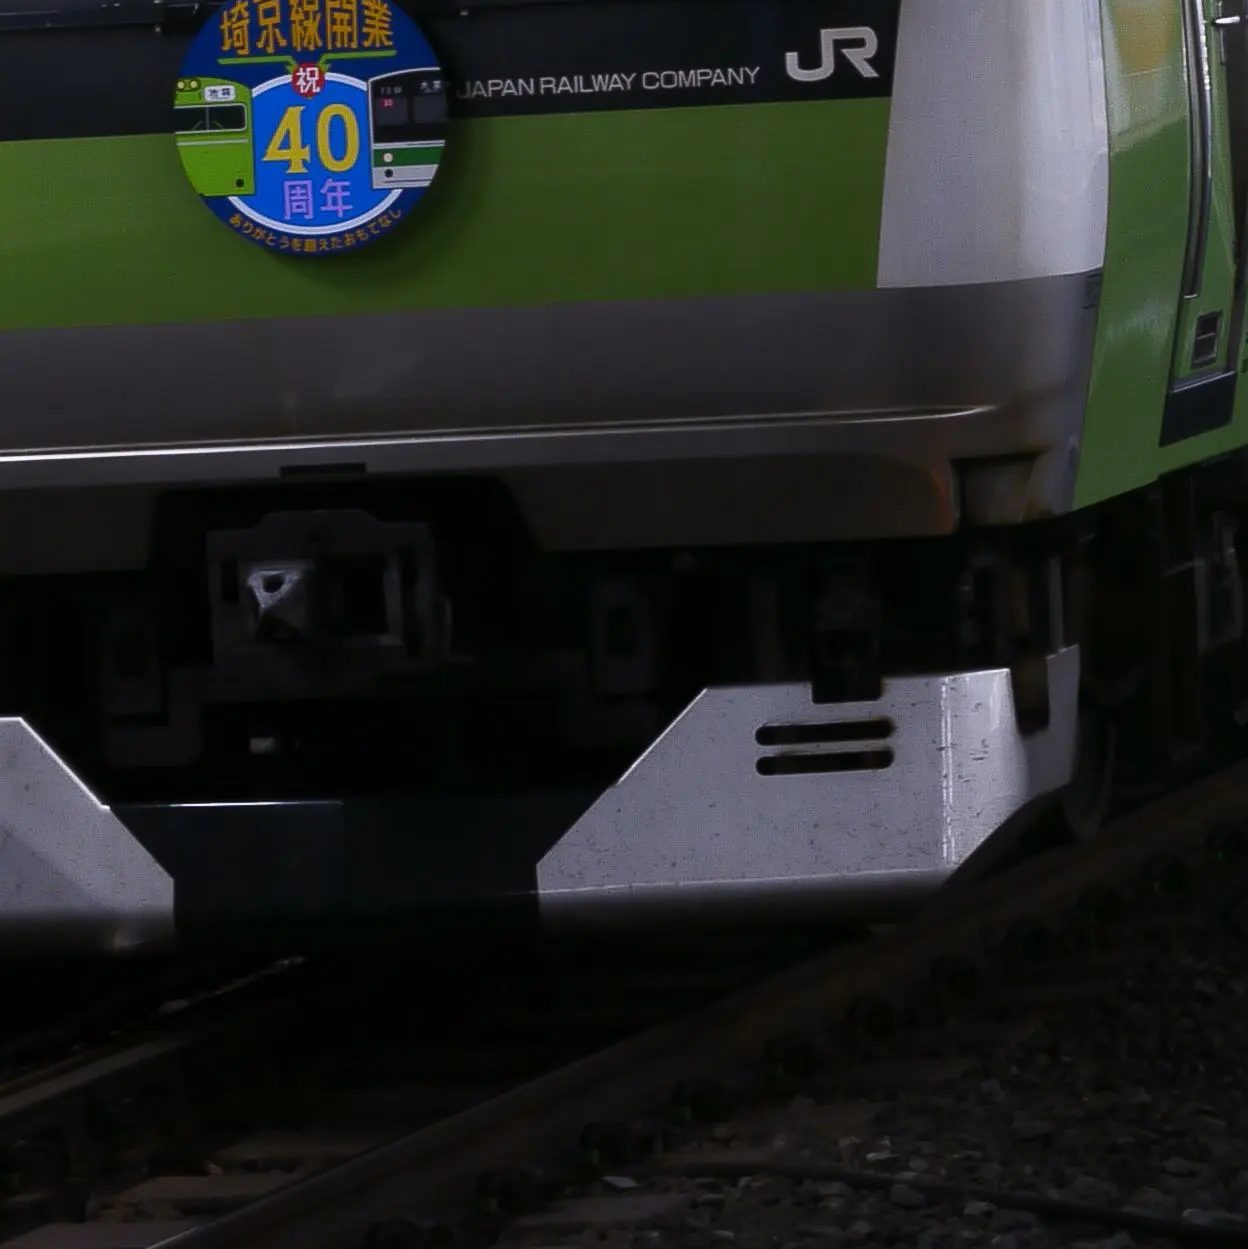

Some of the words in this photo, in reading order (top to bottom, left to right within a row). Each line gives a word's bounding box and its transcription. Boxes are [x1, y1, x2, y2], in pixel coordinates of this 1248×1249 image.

[785, 26, 880, 82] JR
[296, 67, 321, 94] 祝
[457, 77, 535, 100] JAPAN
[539, 72, 637, 95] RAILWAY
[641, 66, 760, 90] COMPANY
[261, 103, 361, 174] 40
[283, 178, 354, 220] 周年
